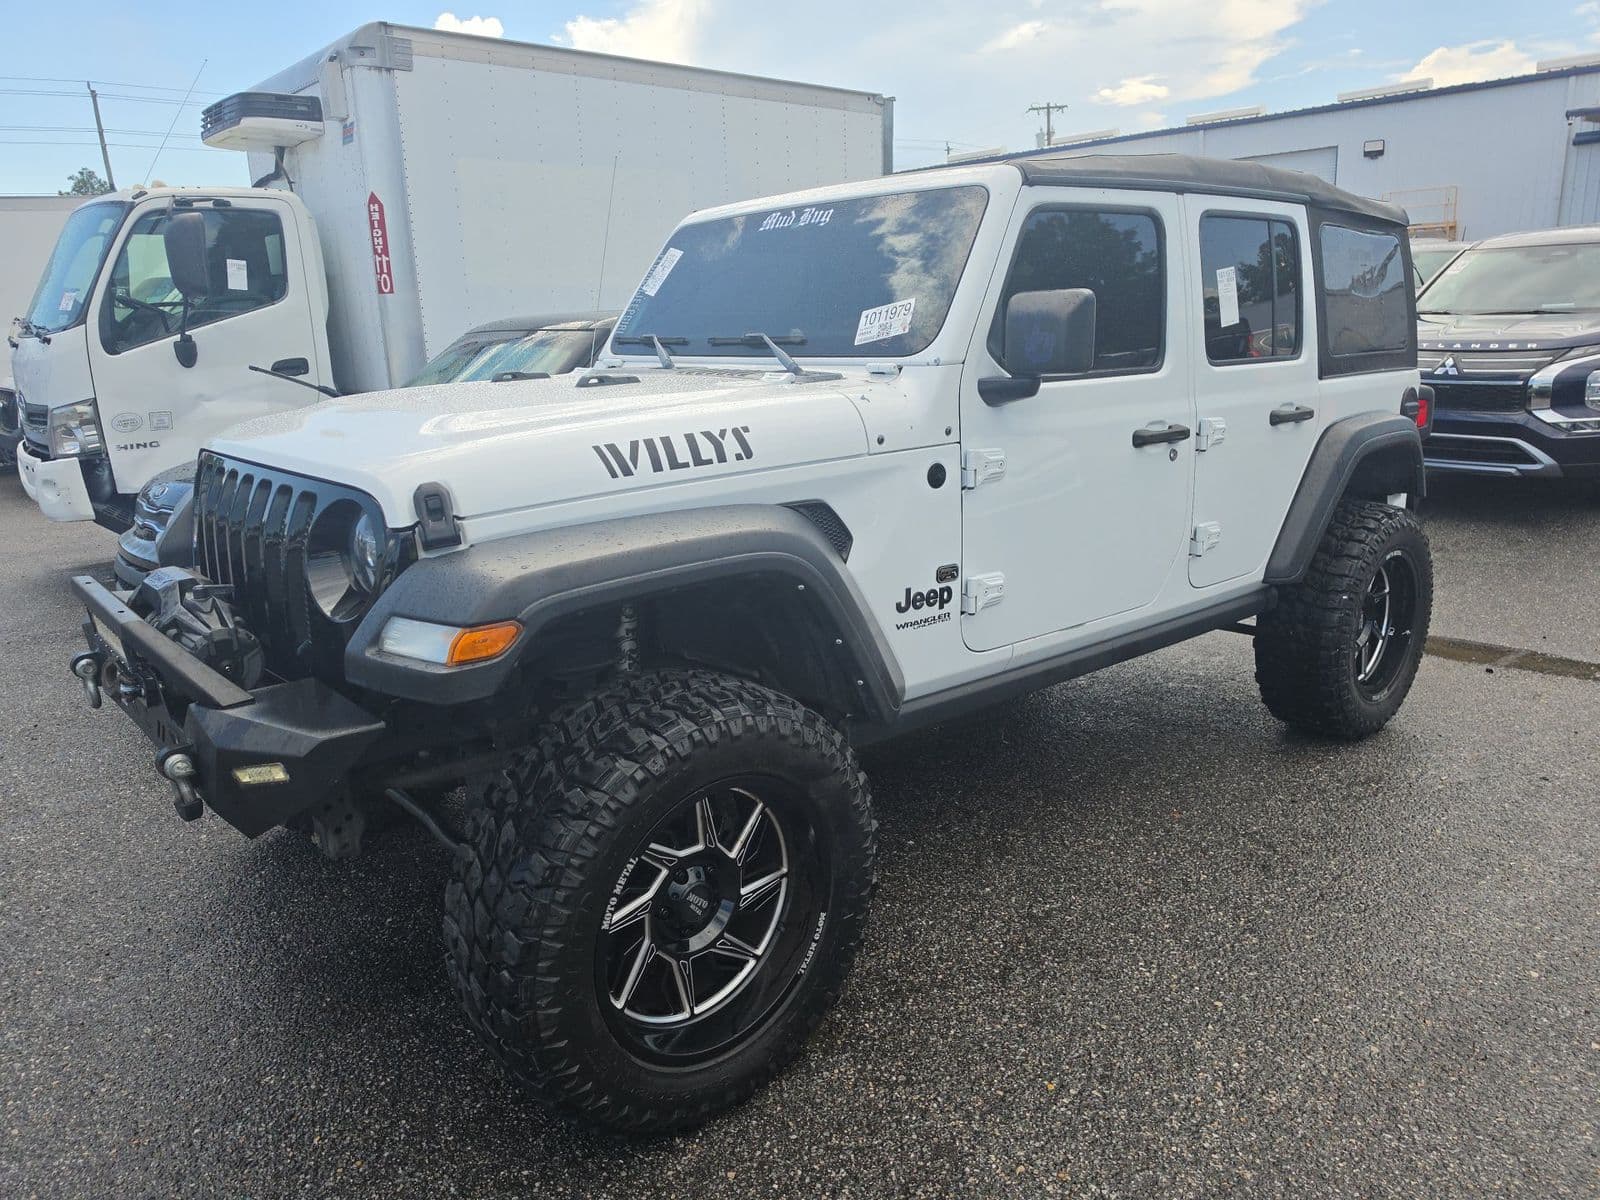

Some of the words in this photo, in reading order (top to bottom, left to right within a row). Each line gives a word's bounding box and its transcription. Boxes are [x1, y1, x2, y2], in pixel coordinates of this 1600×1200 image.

[369, 203, 384, 254] HEIGHT
[758, 210, 796, 231] Mud
[798, 207, 834, 226] Bug
[863, 302, 913, 326] 1011979
[115, 440, 160, 452] HINO
[592, 425, 754, 479] WILLYS
[895, 585, 953, 614] Jeep
[895, 612, 951, 630] WRANGLER
[601, 897, 618, 930] MOTO
[613, 857, 639, 895] METAL
[813, 911, 827, 940] MOTO
